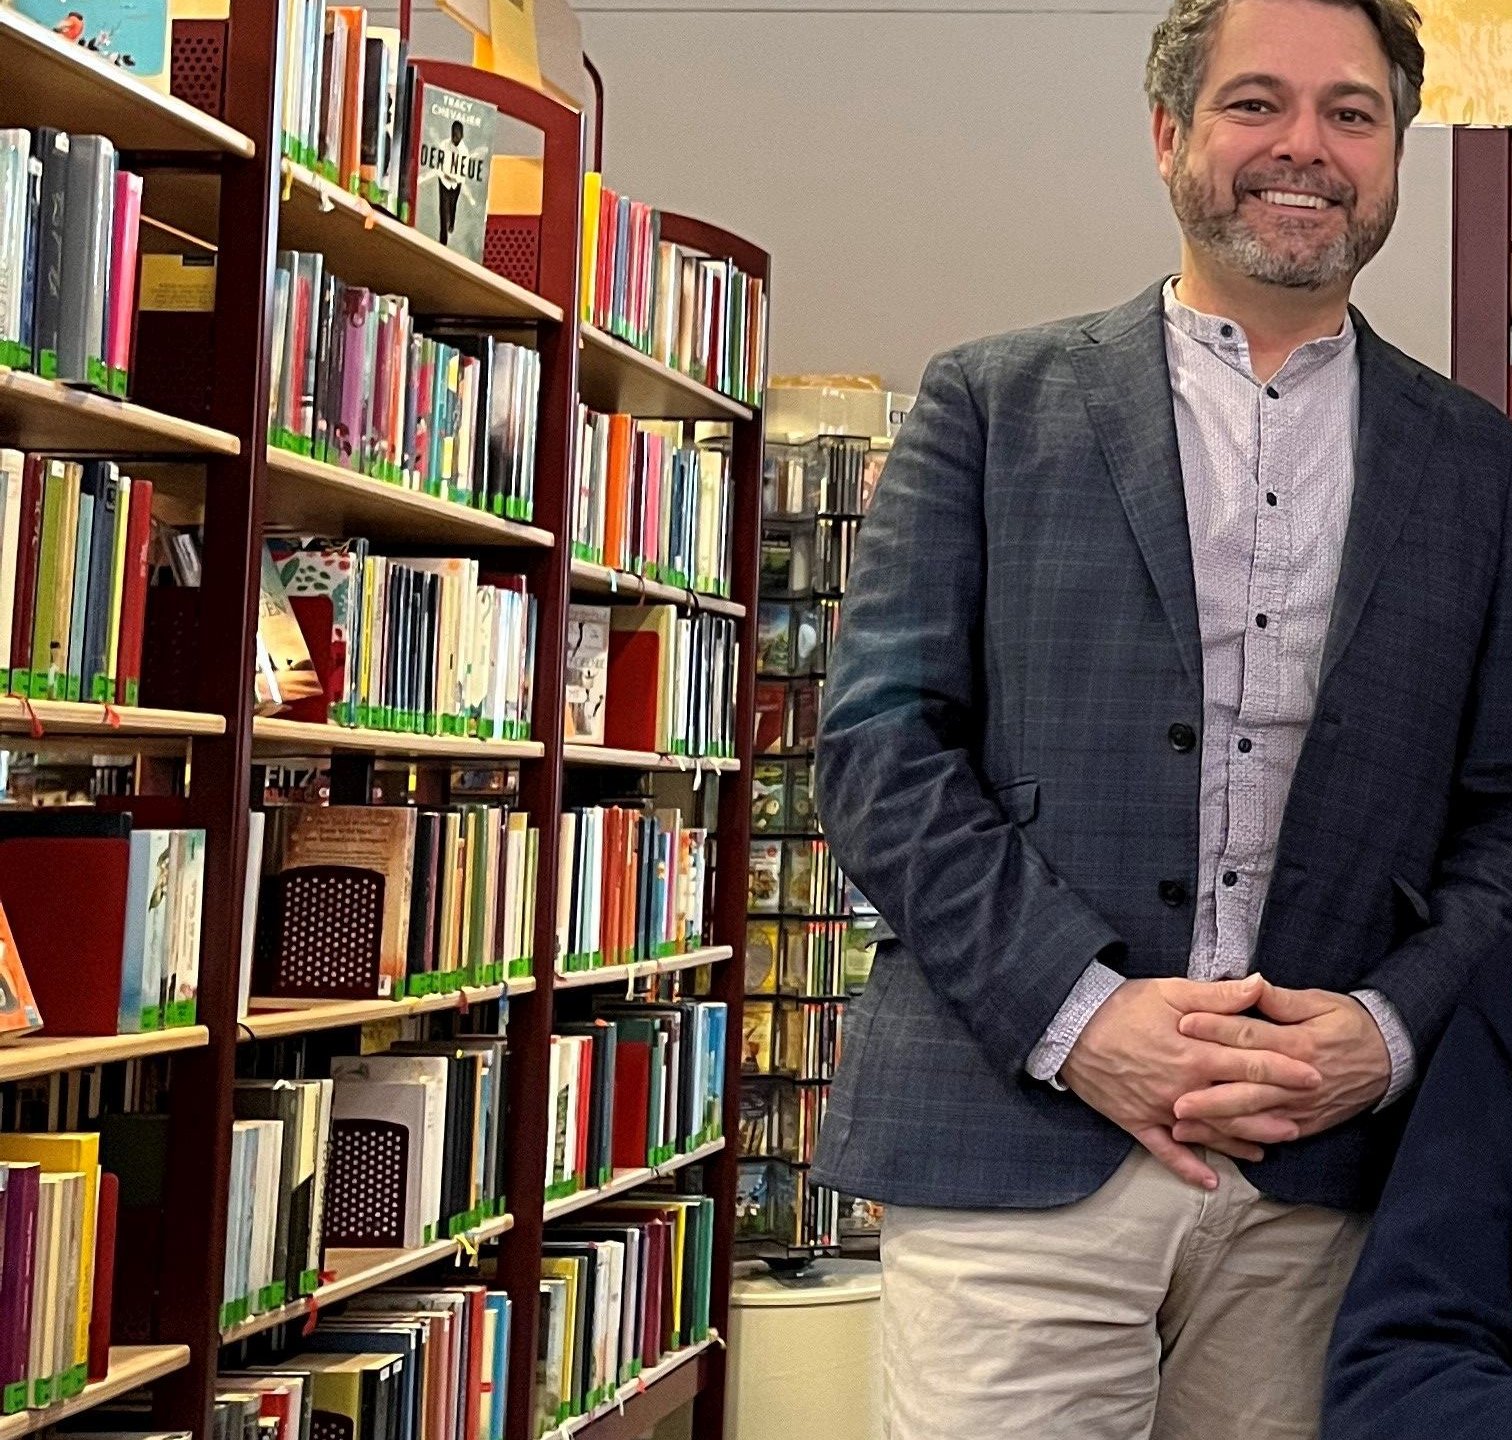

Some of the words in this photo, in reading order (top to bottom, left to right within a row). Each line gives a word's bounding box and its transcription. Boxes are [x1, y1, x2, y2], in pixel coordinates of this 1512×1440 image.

[443, 95, 473, 112] TRACY
[420, 144, 445, 170] DER
[450, 151, 484, 182] NEUE
[265, 765, 322, 787] FITZ
